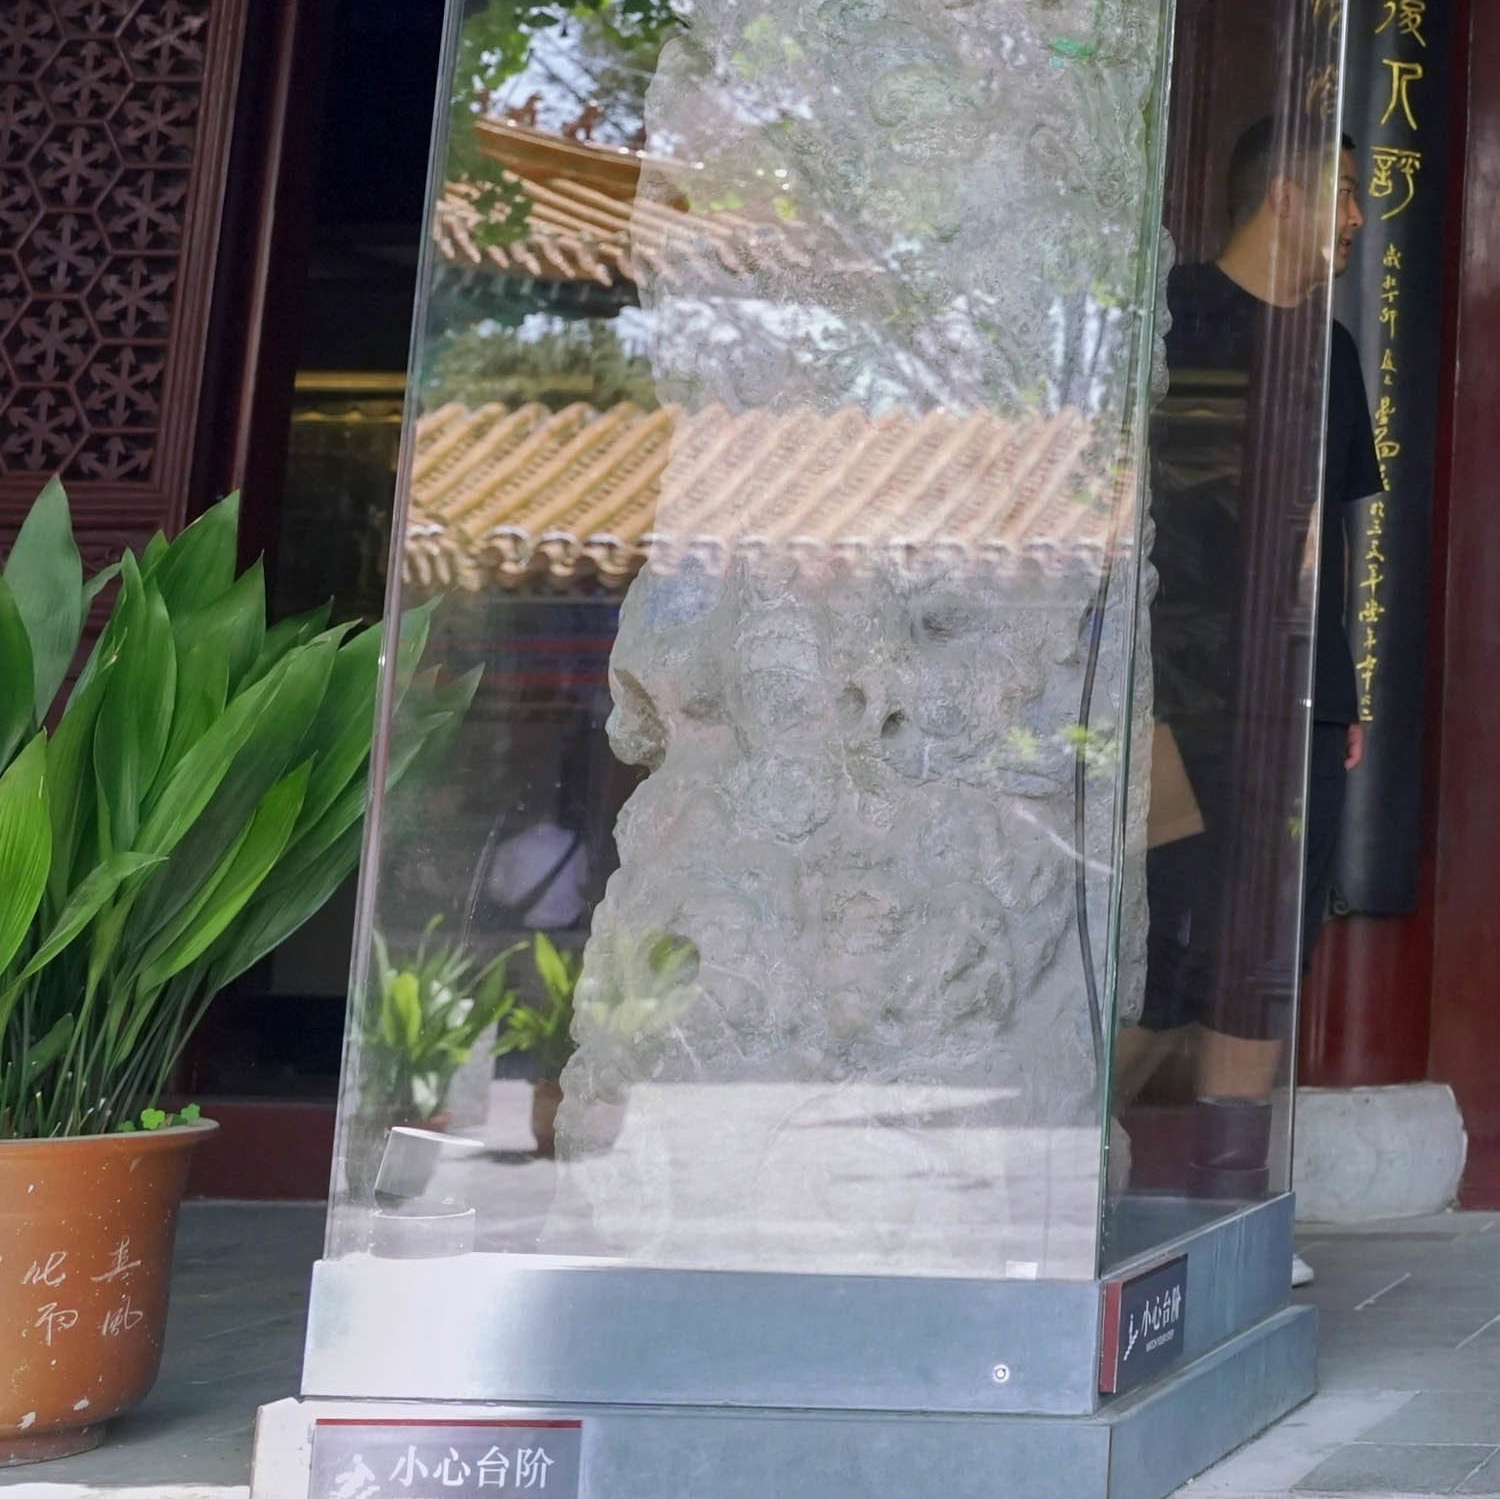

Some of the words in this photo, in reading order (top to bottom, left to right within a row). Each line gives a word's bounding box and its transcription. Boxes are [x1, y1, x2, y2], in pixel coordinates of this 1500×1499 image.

[1140, 1283, 1182, 1338] 小心台阶
[388, 1443, 555, 1490] 小心台阶
